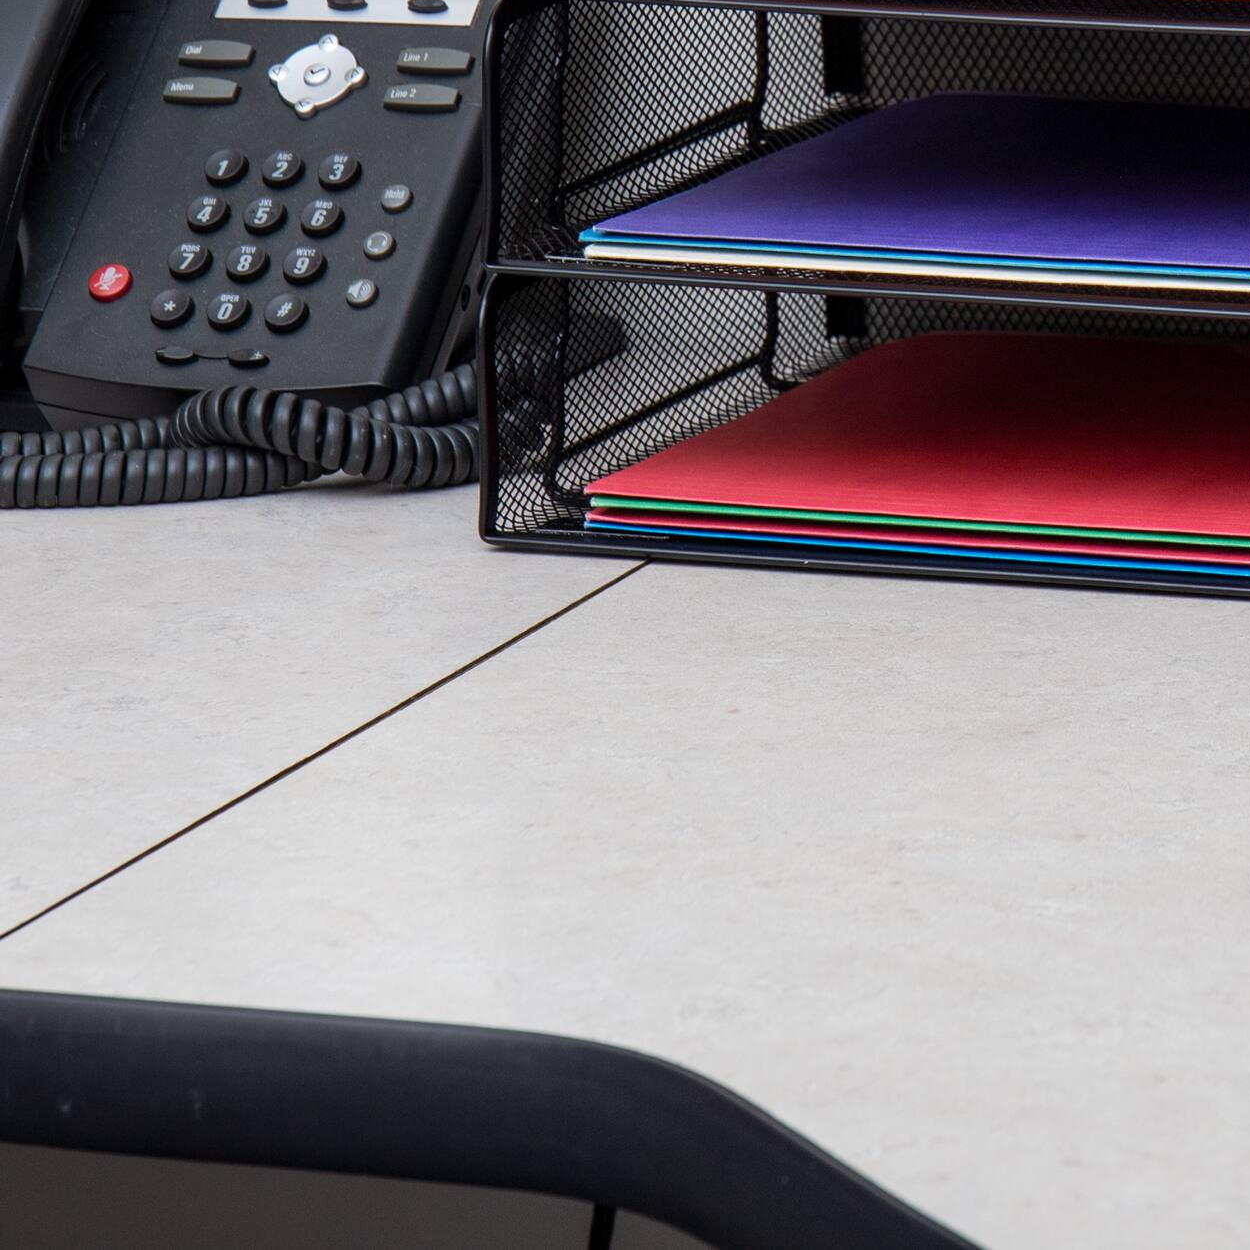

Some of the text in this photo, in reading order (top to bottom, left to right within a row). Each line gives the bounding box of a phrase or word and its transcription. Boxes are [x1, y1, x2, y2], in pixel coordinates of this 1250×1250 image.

[403, 52, 420, 62] Line
[170, 82, 194, 91] Menu
[390, 88, 408, 99] Line
[217, 159, 229, 177] 1
[271, 161, 289, 178] 2
[328, 163, 345, 181] 3
[197, 206, 213, 223] 4
[253, 207, 271, 225] 5
[310, 209, 327, 227] 6
[179, 253, 195, 270] 7
[236, 254, 253, 272] 8
[293, 257, 310, 275] 9
[216, 302, 234, 321] 0
